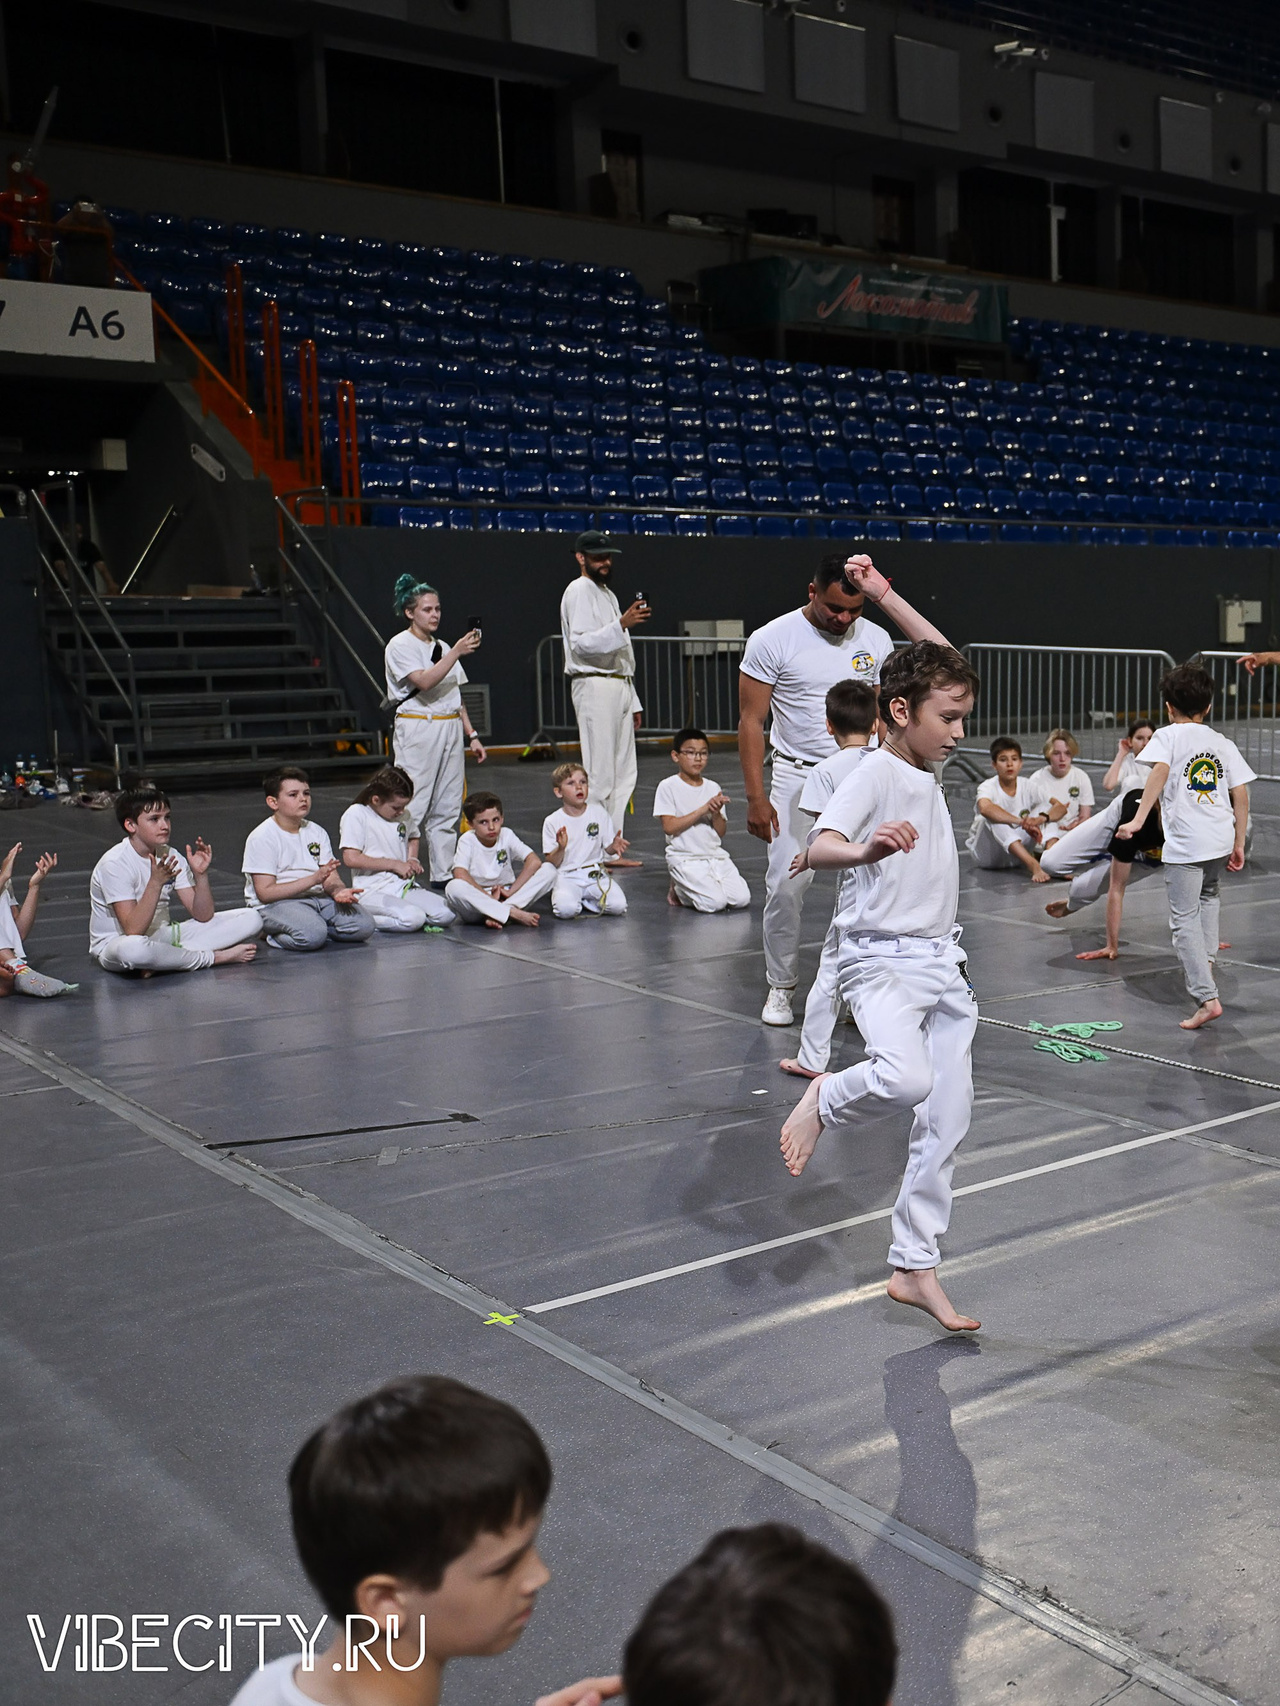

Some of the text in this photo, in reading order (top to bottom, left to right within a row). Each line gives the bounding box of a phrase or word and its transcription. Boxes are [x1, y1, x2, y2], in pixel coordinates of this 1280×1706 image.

[69, 306, 125, 341] A6
[1205, 752, 1215, 760] DE
[1214, 759, 1224, 779] OURO
